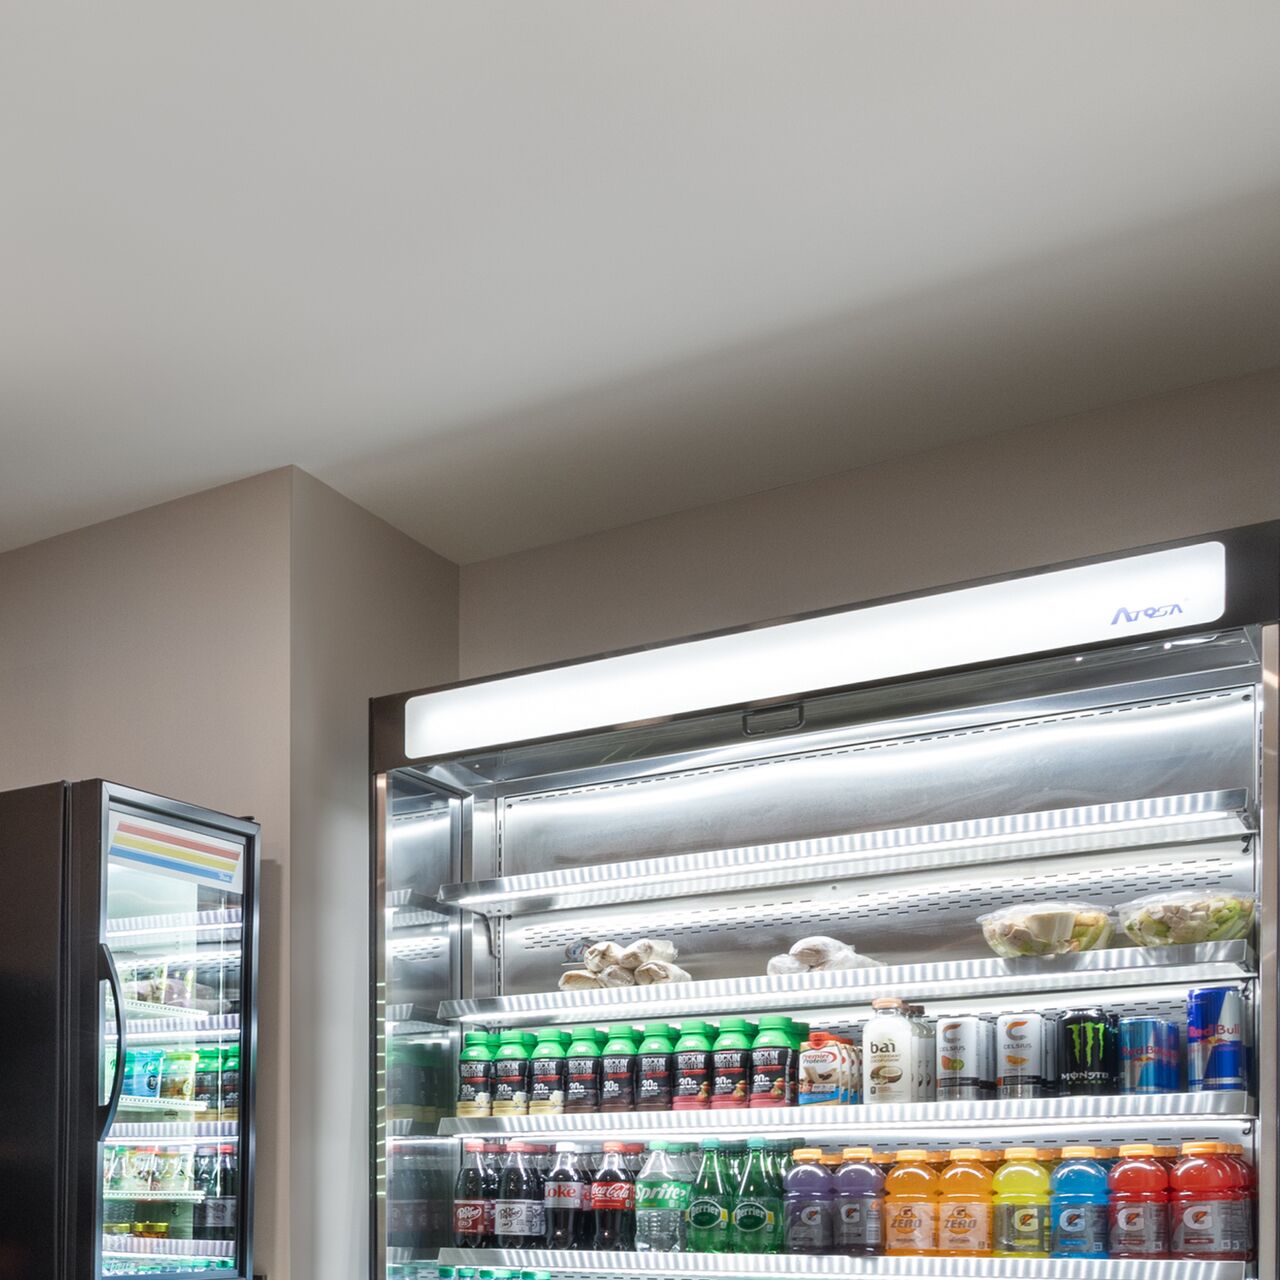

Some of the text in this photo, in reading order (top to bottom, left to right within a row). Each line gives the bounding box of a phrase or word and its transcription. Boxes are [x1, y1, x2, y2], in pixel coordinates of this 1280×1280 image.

[1189, 1024, 1240, 1038] Red Bull
[870, 1041, 896, 1053] bai
[635, 1183, 679, 1200] Sprite
[890, 1217, 922, 1229] ZERO
[944, 1218, 977, 1230] ZERO
[1014, 1208, 1038, 1232] G
[1059, 1208, 1085, 1232] G
[1117, 1207, 1144, 1231] G
[1183, 1206, 1213, 1230] G
